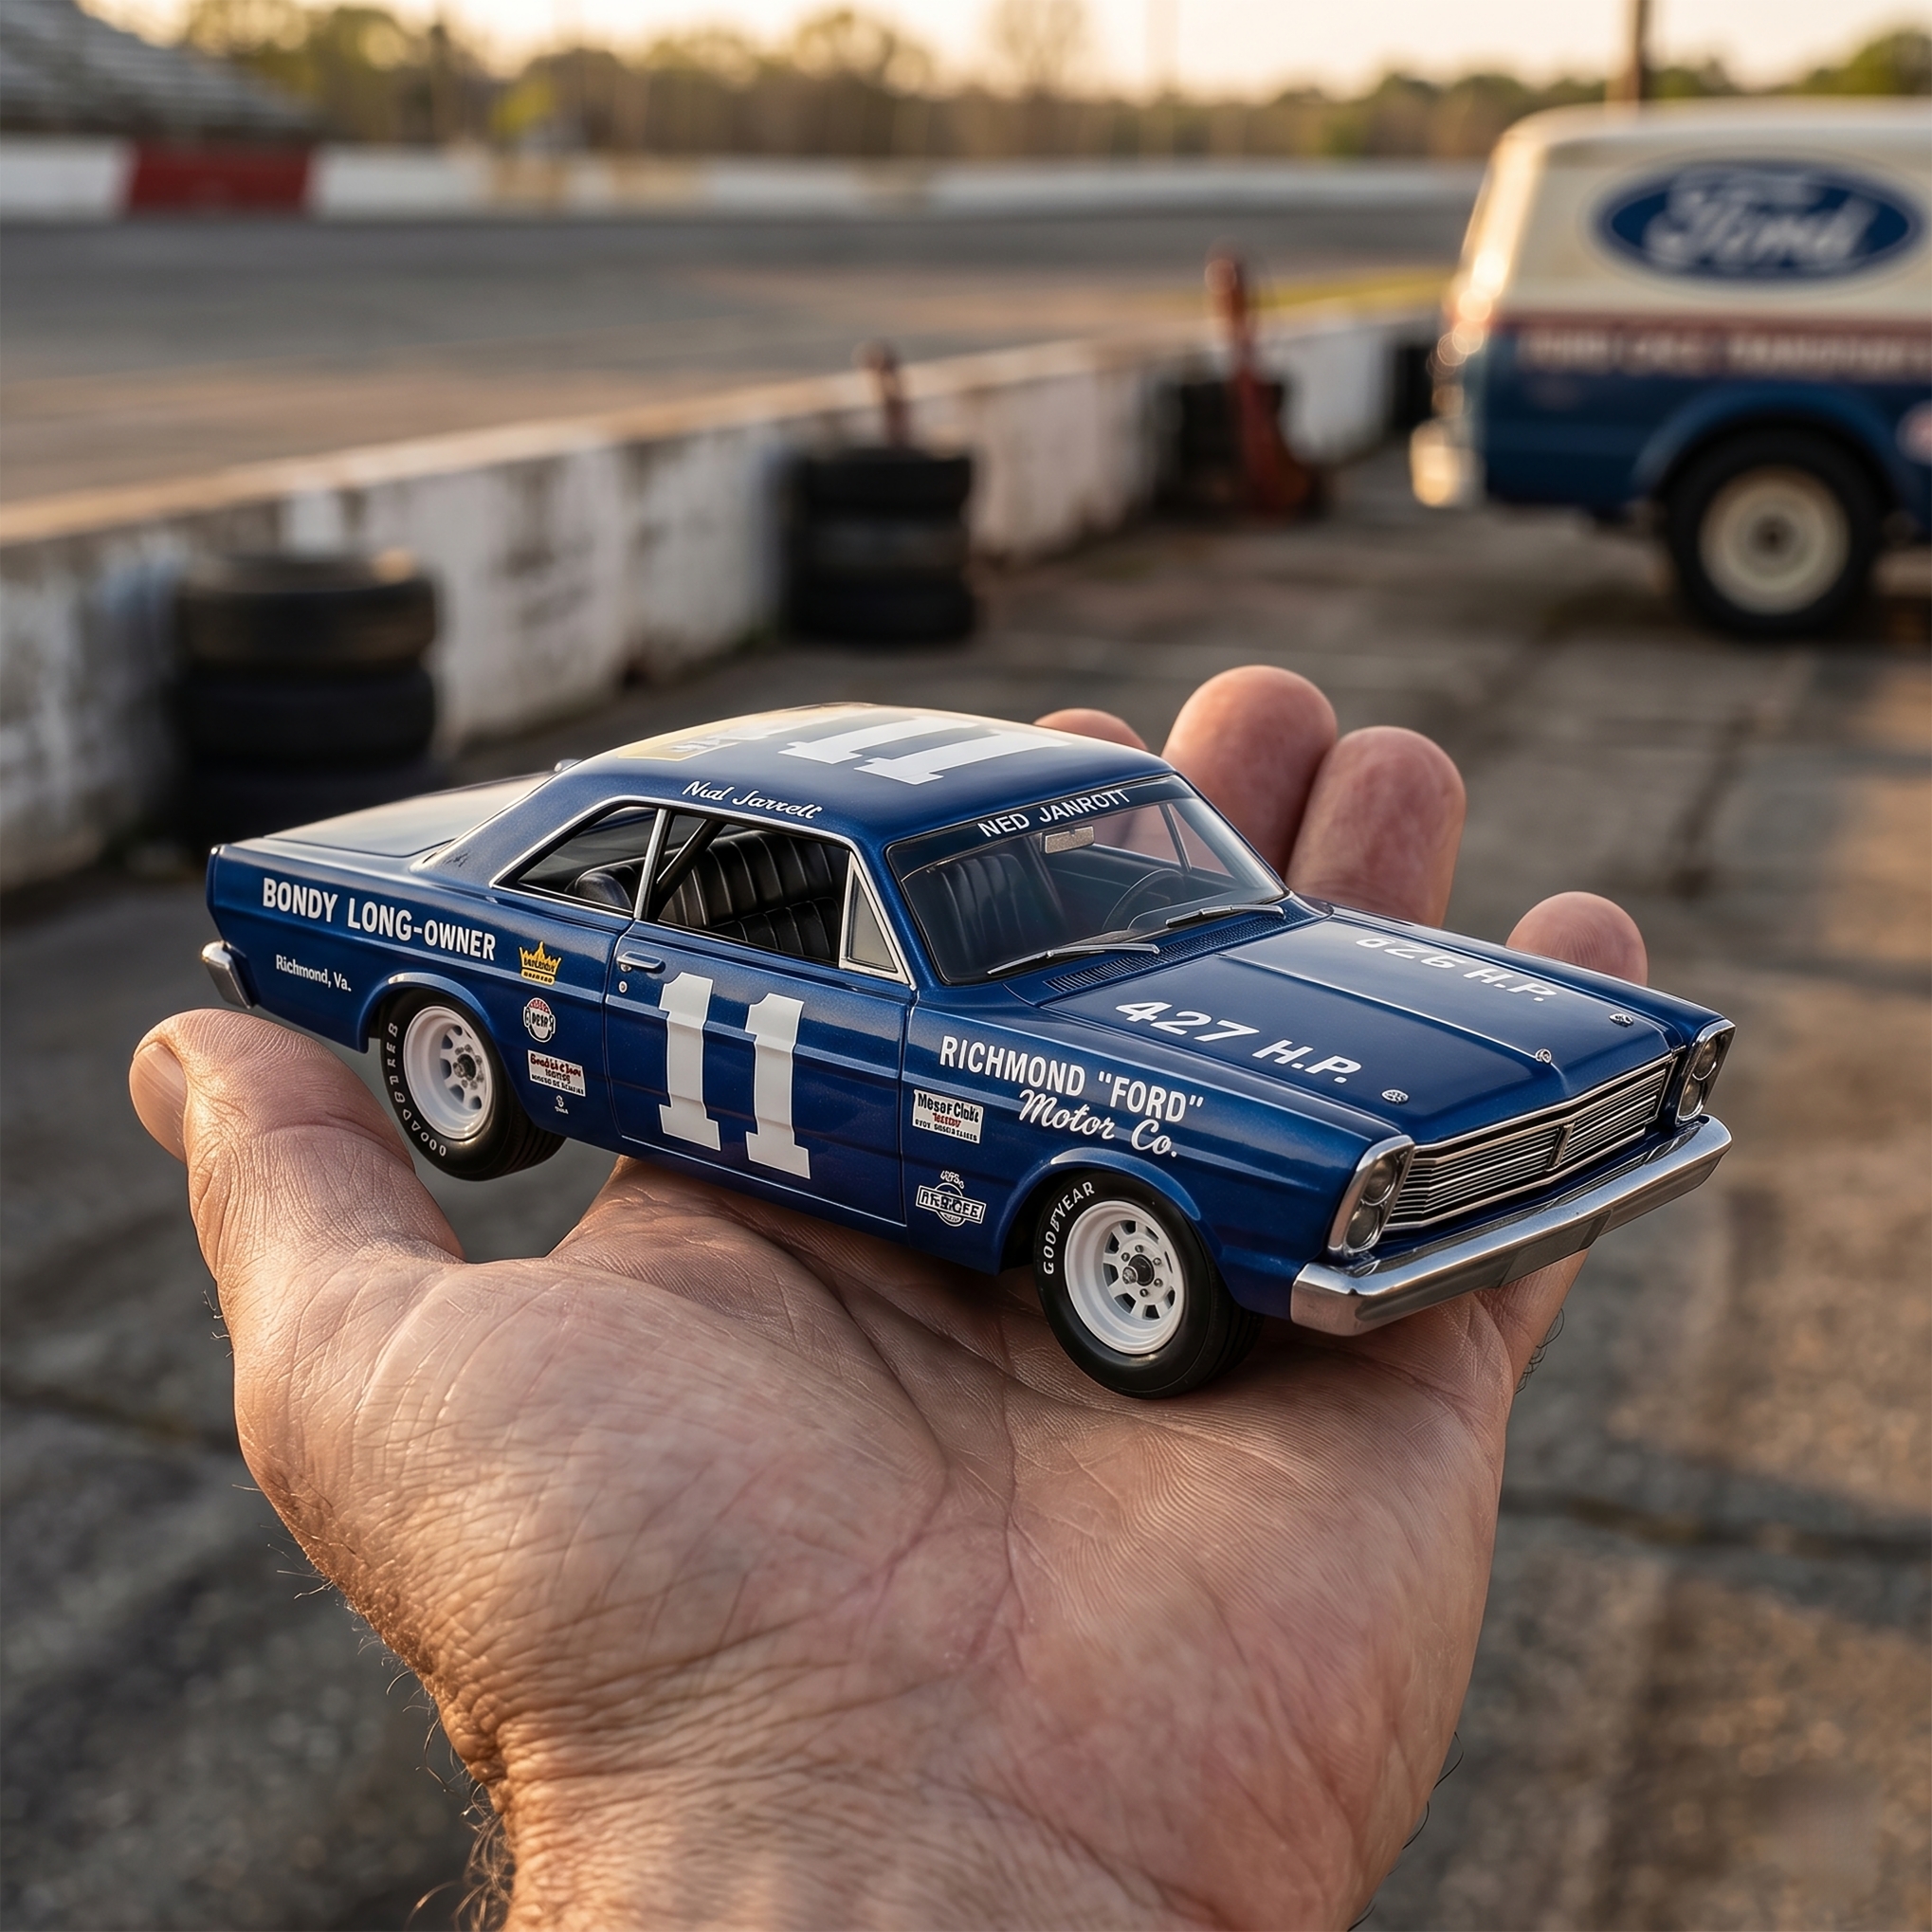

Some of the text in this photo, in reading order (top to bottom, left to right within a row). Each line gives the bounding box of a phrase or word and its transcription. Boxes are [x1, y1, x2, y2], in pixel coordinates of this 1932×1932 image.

[778, 716, 1073, 785] 11
[977, 789, 1131, 838] NED JANROTT
[263, 877, 496, 961] BONDY LONG-OWNER
[275, 954, 353, 993] Richmond, Va.
[1463, 968, 1558, 1002] H.P.
[659, 972, 811, 1179] 11
[1115, 1001, 1363, 1084] 427 H.P.
[939, 1035, 1204, 1123] RICHMOND "FORD"
[1018, 1089, 1116, 1140] Motor
[1131, 1119, 1177, 1157] Co.
